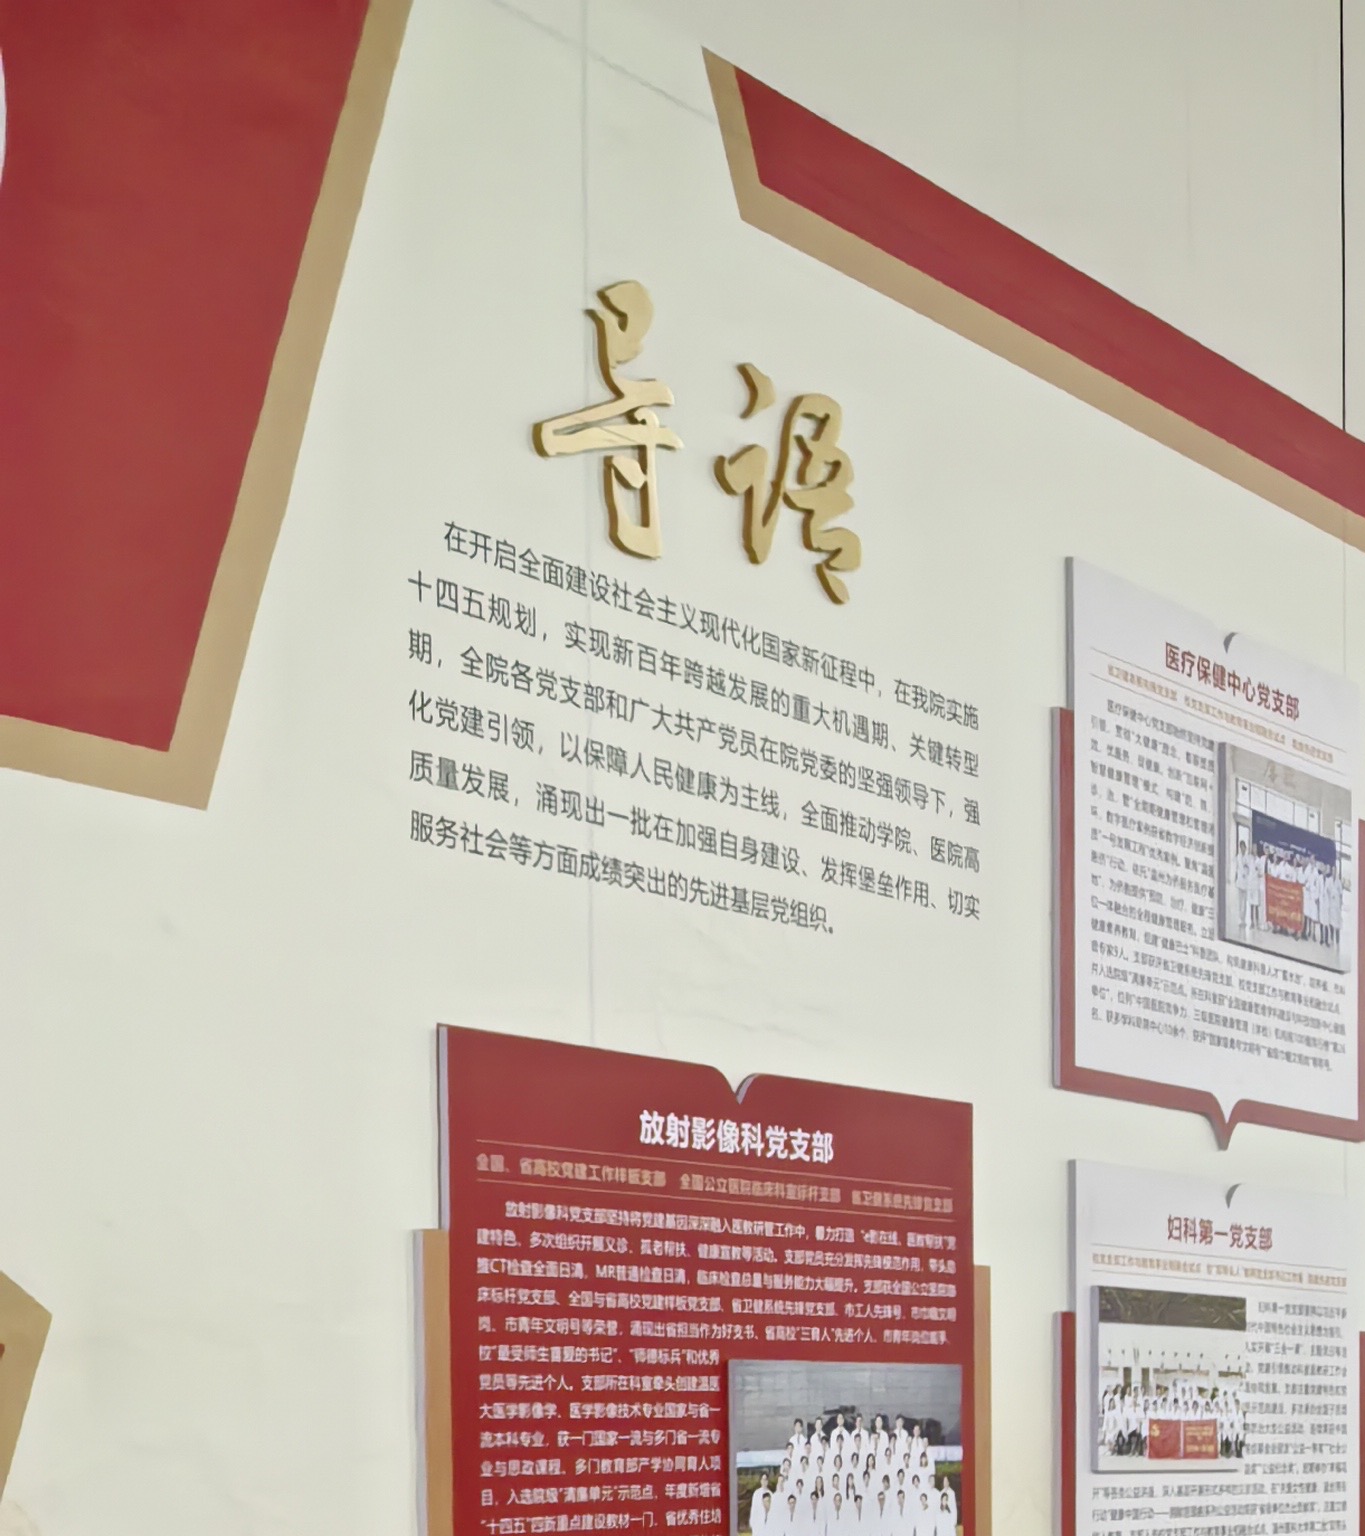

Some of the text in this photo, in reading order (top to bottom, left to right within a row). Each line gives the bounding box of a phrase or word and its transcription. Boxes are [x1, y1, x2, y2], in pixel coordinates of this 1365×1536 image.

[1165, 641, 1300, 721] 医疗保健中心党支部
[640, 1110, 834, 1164] 放射影像科党支部
[1167, 1214, 1273, 1252] 妇科第一党支部
